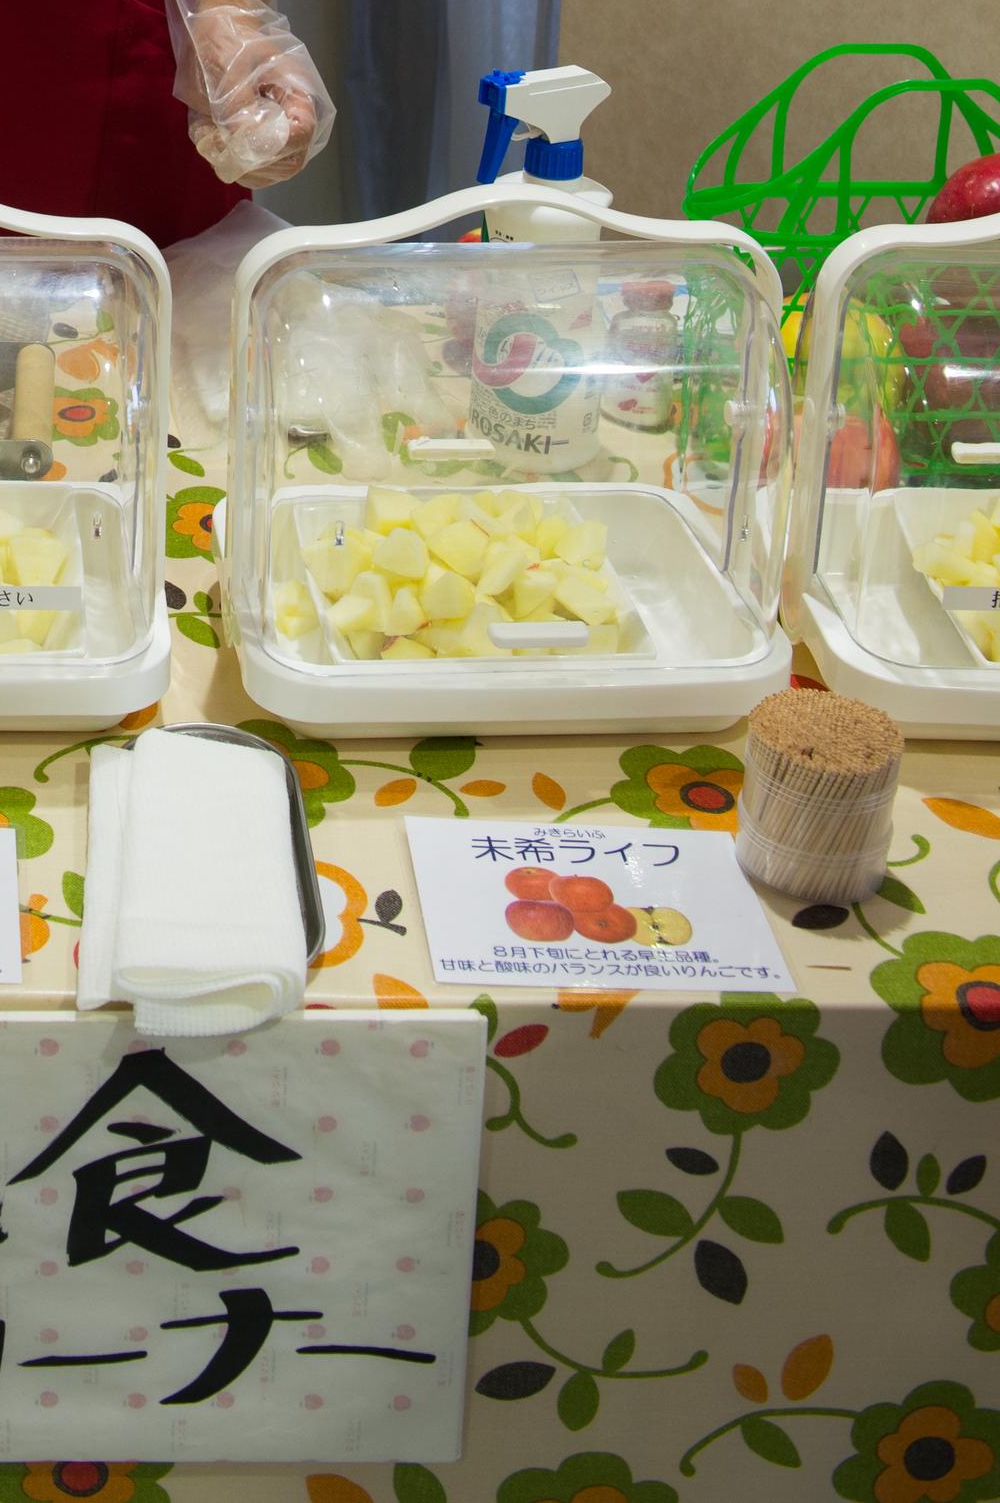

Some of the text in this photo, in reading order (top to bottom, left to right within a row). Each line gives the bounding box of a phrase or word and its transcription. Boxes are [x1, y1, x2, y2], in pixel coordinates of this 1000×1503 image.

[471, 835, 681, 867] 未希ライフ
[440, 959, 783, 981] 甘味と酸味のバランスが良いりんごです。
